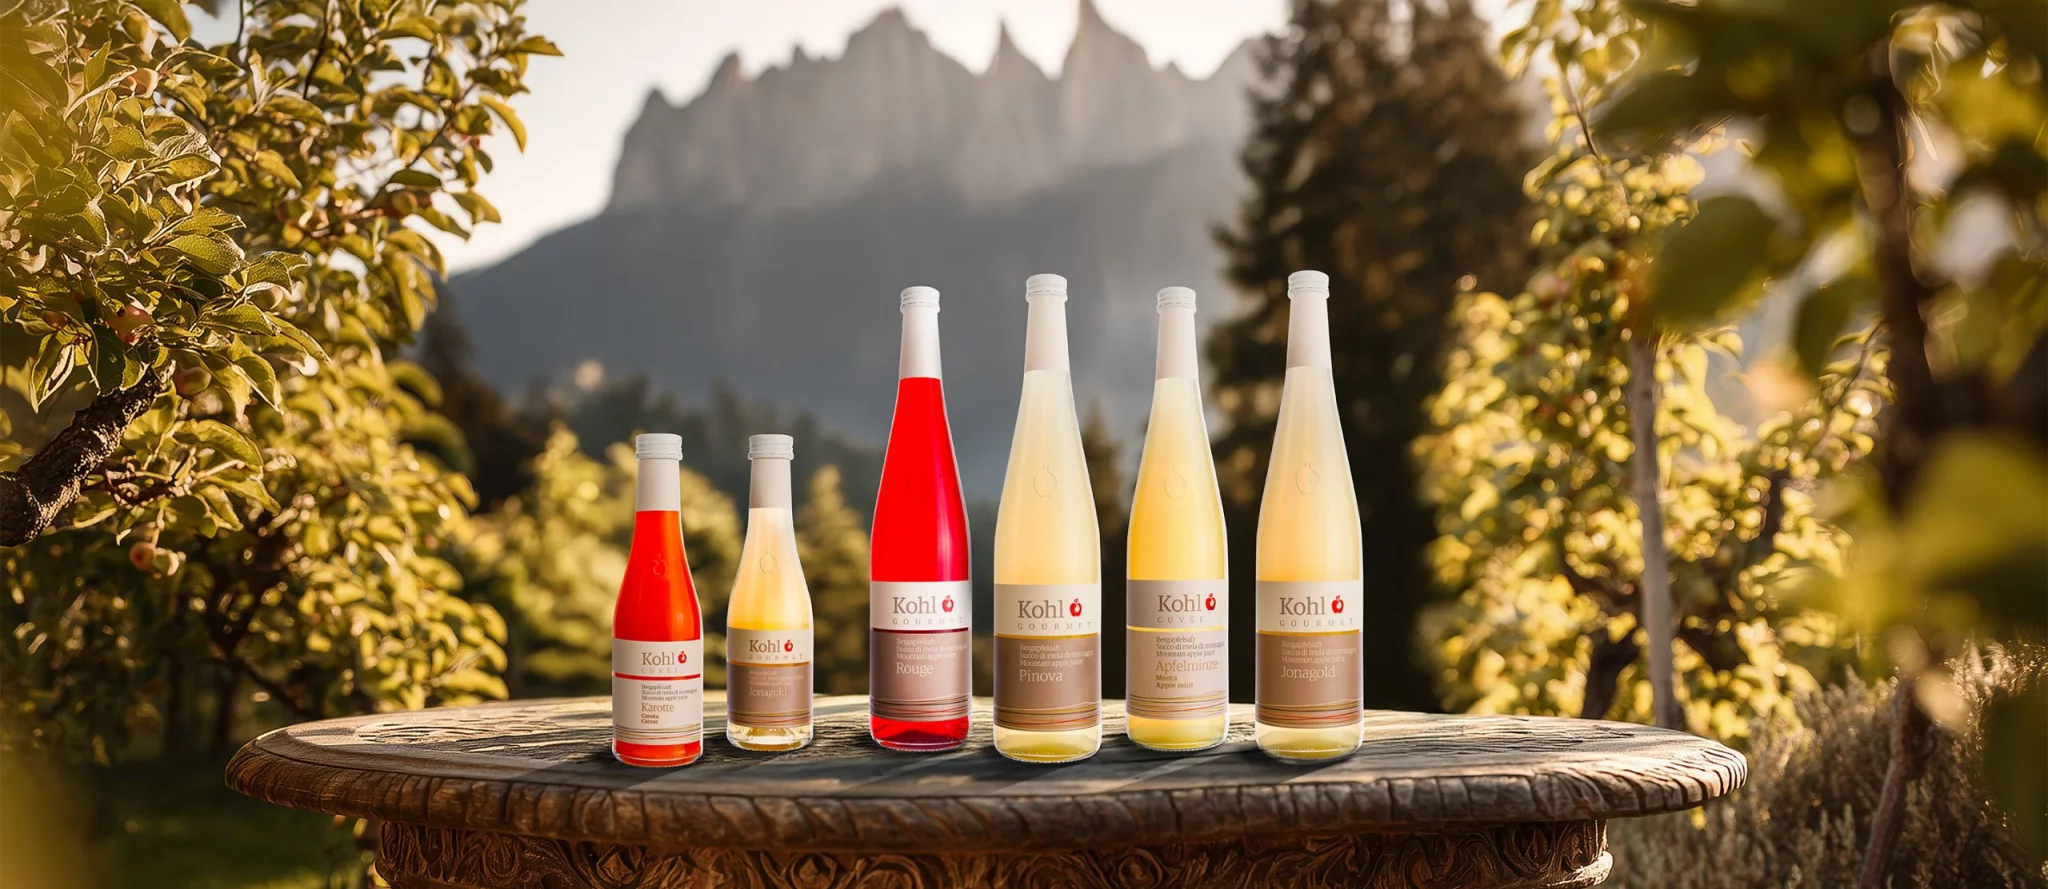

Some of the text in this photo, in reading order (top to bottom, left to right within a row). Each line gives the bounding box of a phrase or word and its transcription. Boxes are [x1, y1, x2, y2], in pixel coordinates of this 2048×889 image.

[892, 596, 937, 615] Kohl
[1017, 600, 1064, 619] Kohl
[1157, 594, 1201, 612] Kohl
[1279, 596, 1326, 616] Kohl
[892, 617, 963, 626] GOURMET
[1017, 621, 1091, 630] GOURMET
[1279, 618, 1353, 627] GOURMET
[748, 639, 781, 653] Kohl
[641, 652, 675, 666] Kohl
[1186, 650, 1203, 658] apple
[896, 662, 934, 677] Rouge
[1019, 659, 1051, 667] Mountain
[1051, 659, 1069, 668] apple
[1155, 660, 1219, 674] Apfelminze
[1019, 669, 1063, 682] Pinova
[1281, 665, 1336, 681] Jonagold
[1155, 681, 1176, 689] Apple
[748, 687, 788, 699] Jonagold
[641, 702, 675, 712] Karotte
